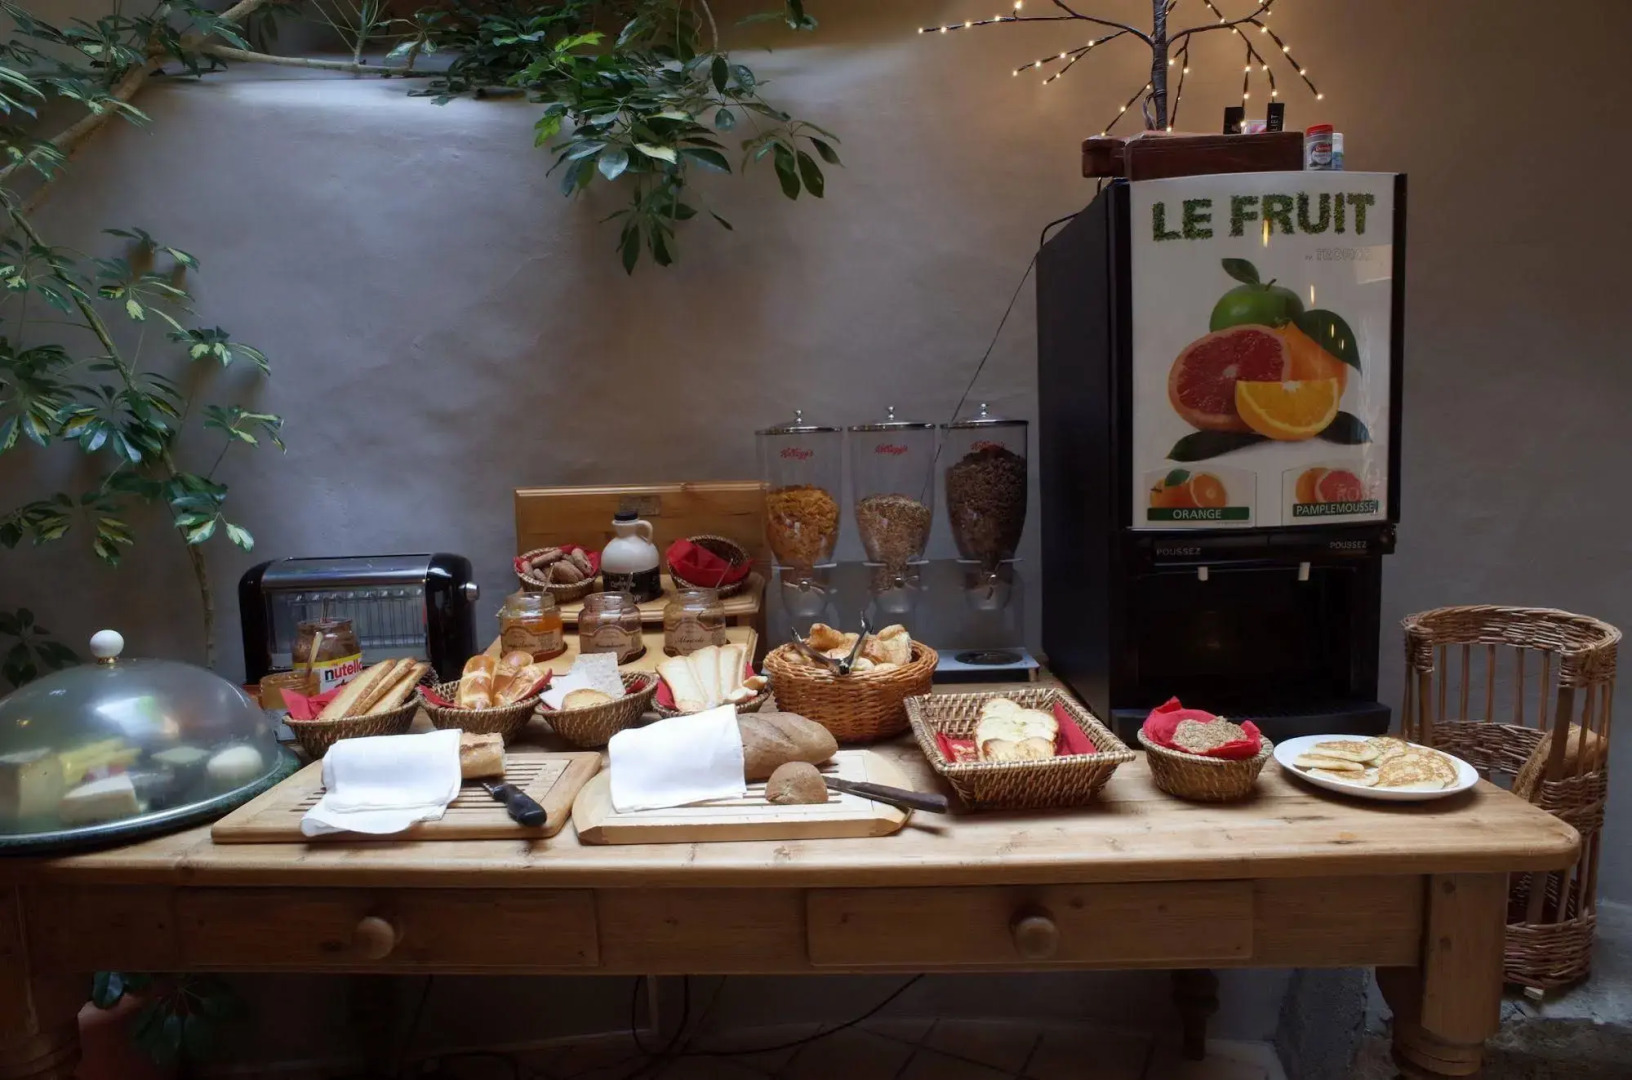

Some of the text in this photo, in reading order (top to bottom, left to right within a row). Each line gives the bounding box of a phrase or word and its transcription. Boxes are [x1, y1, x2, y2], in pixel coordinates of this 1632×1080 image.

[1152, 191, 1376, 241] LE FRUIT
[1172, 508, 1222, 520] ORANGE
[1296, 501, 1375, 515] PAMPLEMOUSSE
[1156, 546, 1201, 556] POUSSEZ
[1329, 540, 1368, 550] POUSSEZ
